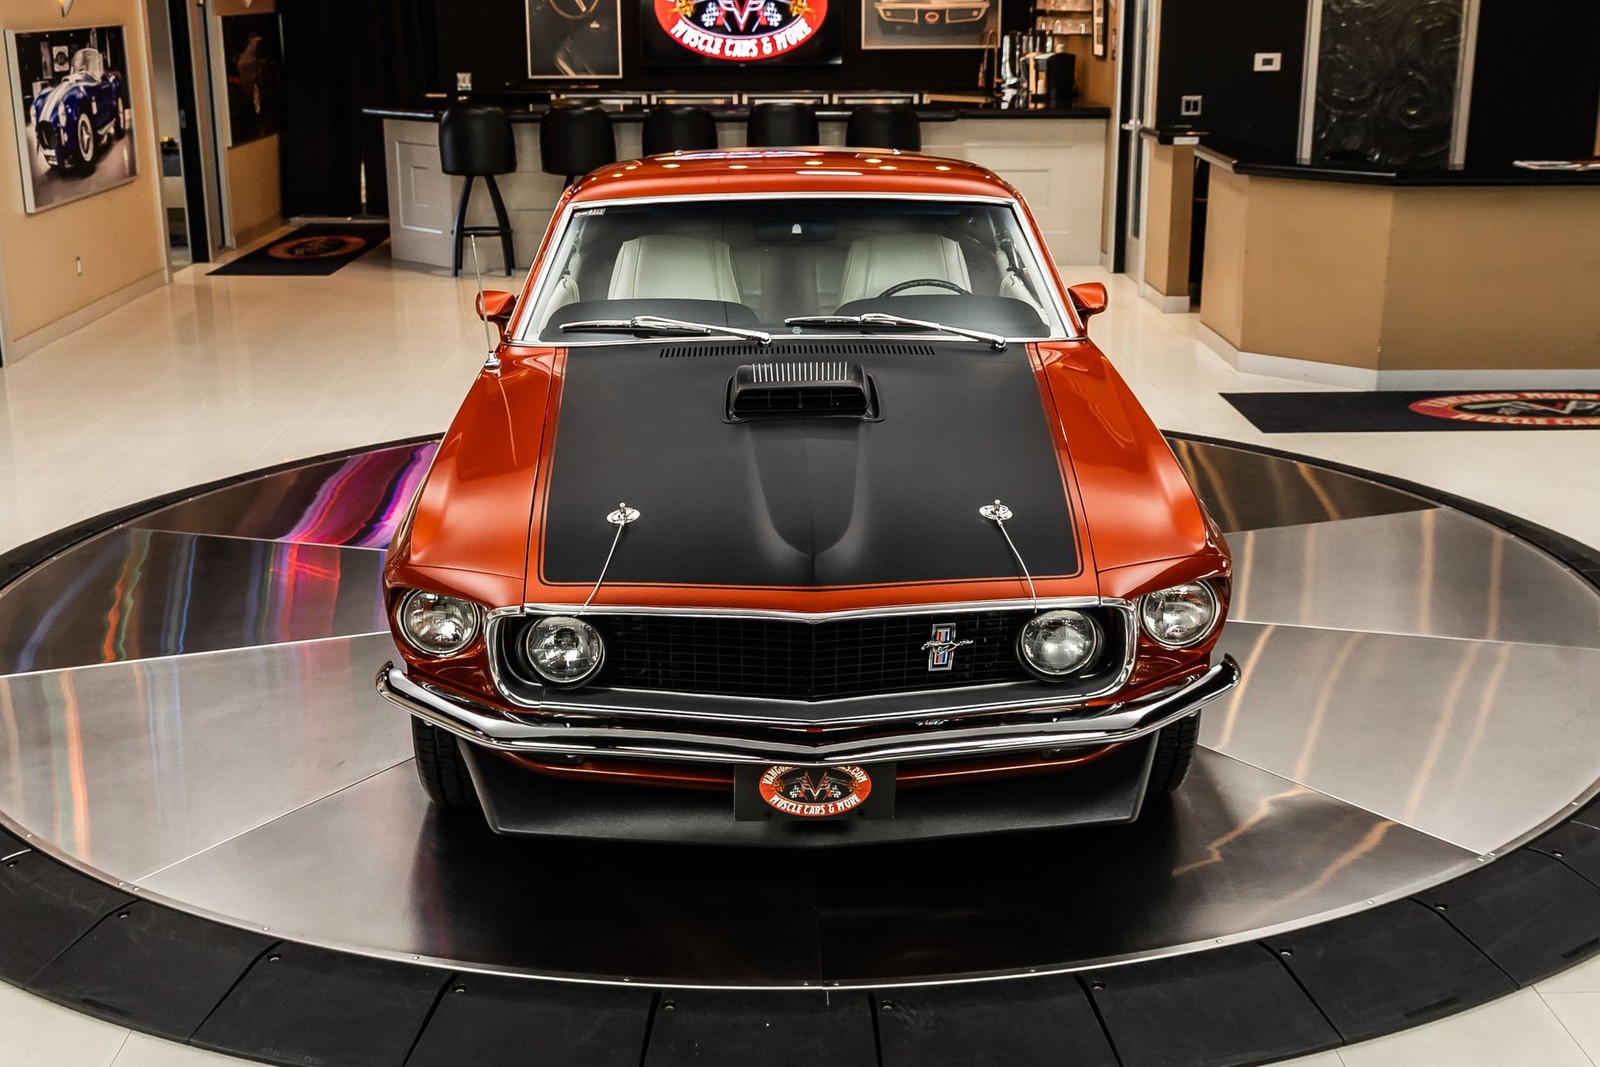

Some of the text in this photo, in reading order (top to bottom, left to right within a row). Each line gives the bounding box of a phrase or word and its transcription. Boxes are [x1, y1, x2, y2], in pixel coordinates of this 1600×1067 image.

[670, 18, 812, 57] MUSCLE CARS & MORE
[769, 794, 861, 815] MUSCLE CARS & MORE
